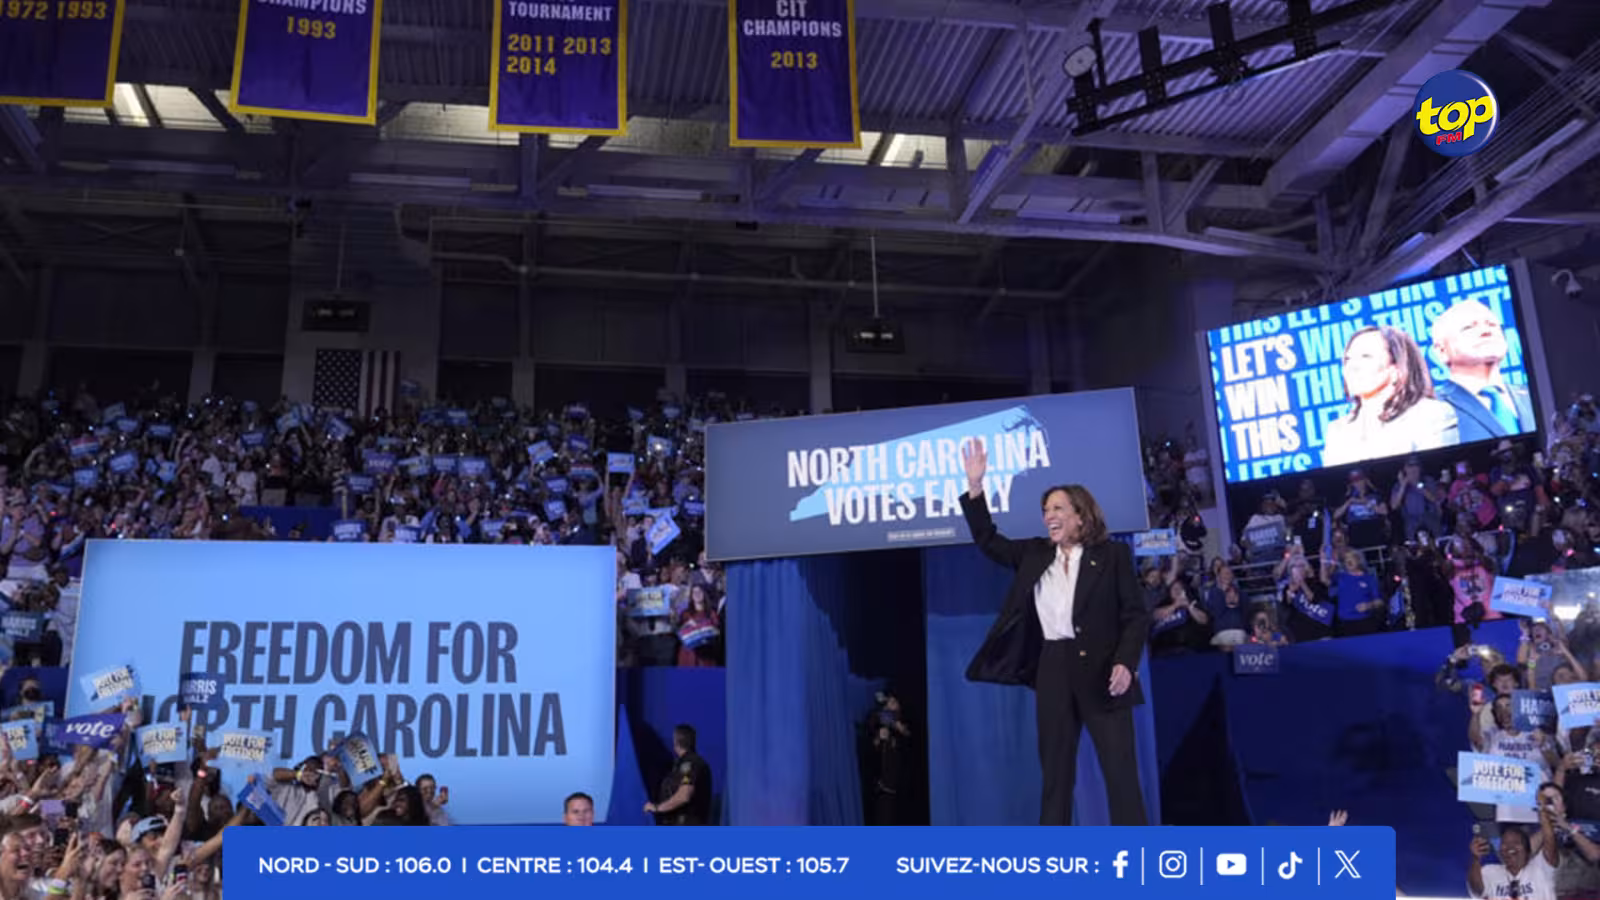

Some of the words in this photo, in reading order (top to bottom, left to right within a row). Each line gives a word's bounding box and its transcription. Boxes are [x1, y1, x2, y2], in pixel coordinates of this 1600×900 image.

[57, 1, 107, 19] 1993
[508, 1, 613, 21] TOURNAMENT
[776, 0, 807, 17] CIT
[287, 16, 336, 39] 1993
[743, 19, 843, 37] CHAMPIONS
[507, 34, 554, 53] 2011
[563, 37, 611, 55] 2013
[507, 56, 556, 75] 2014
[770, 51, 818, 69] 2013
[1220, 333, 1298, 383] LET'S
[1224, 374, 1291, 421] WIN
[1231, 413, 1302, 461] THIS
[788, 443, 888, 487] NORTH
[825, 480, 916, 526] VOTES
[924, 473, 1014, 518] EALY
[180, 620, 412, 685] FREEDOM
[426, 620, 519, 684] FOR
[1239, 653, 1274, 667] vote
[66, 719, 115, 739] vote
[311, 693, 567, 759] CAROLINA
[1472, 759, 1502, 776] VOTE
[1503, 762, 1525, 780] FOR
[1472, 773, 1526, 792] FREEDOM
